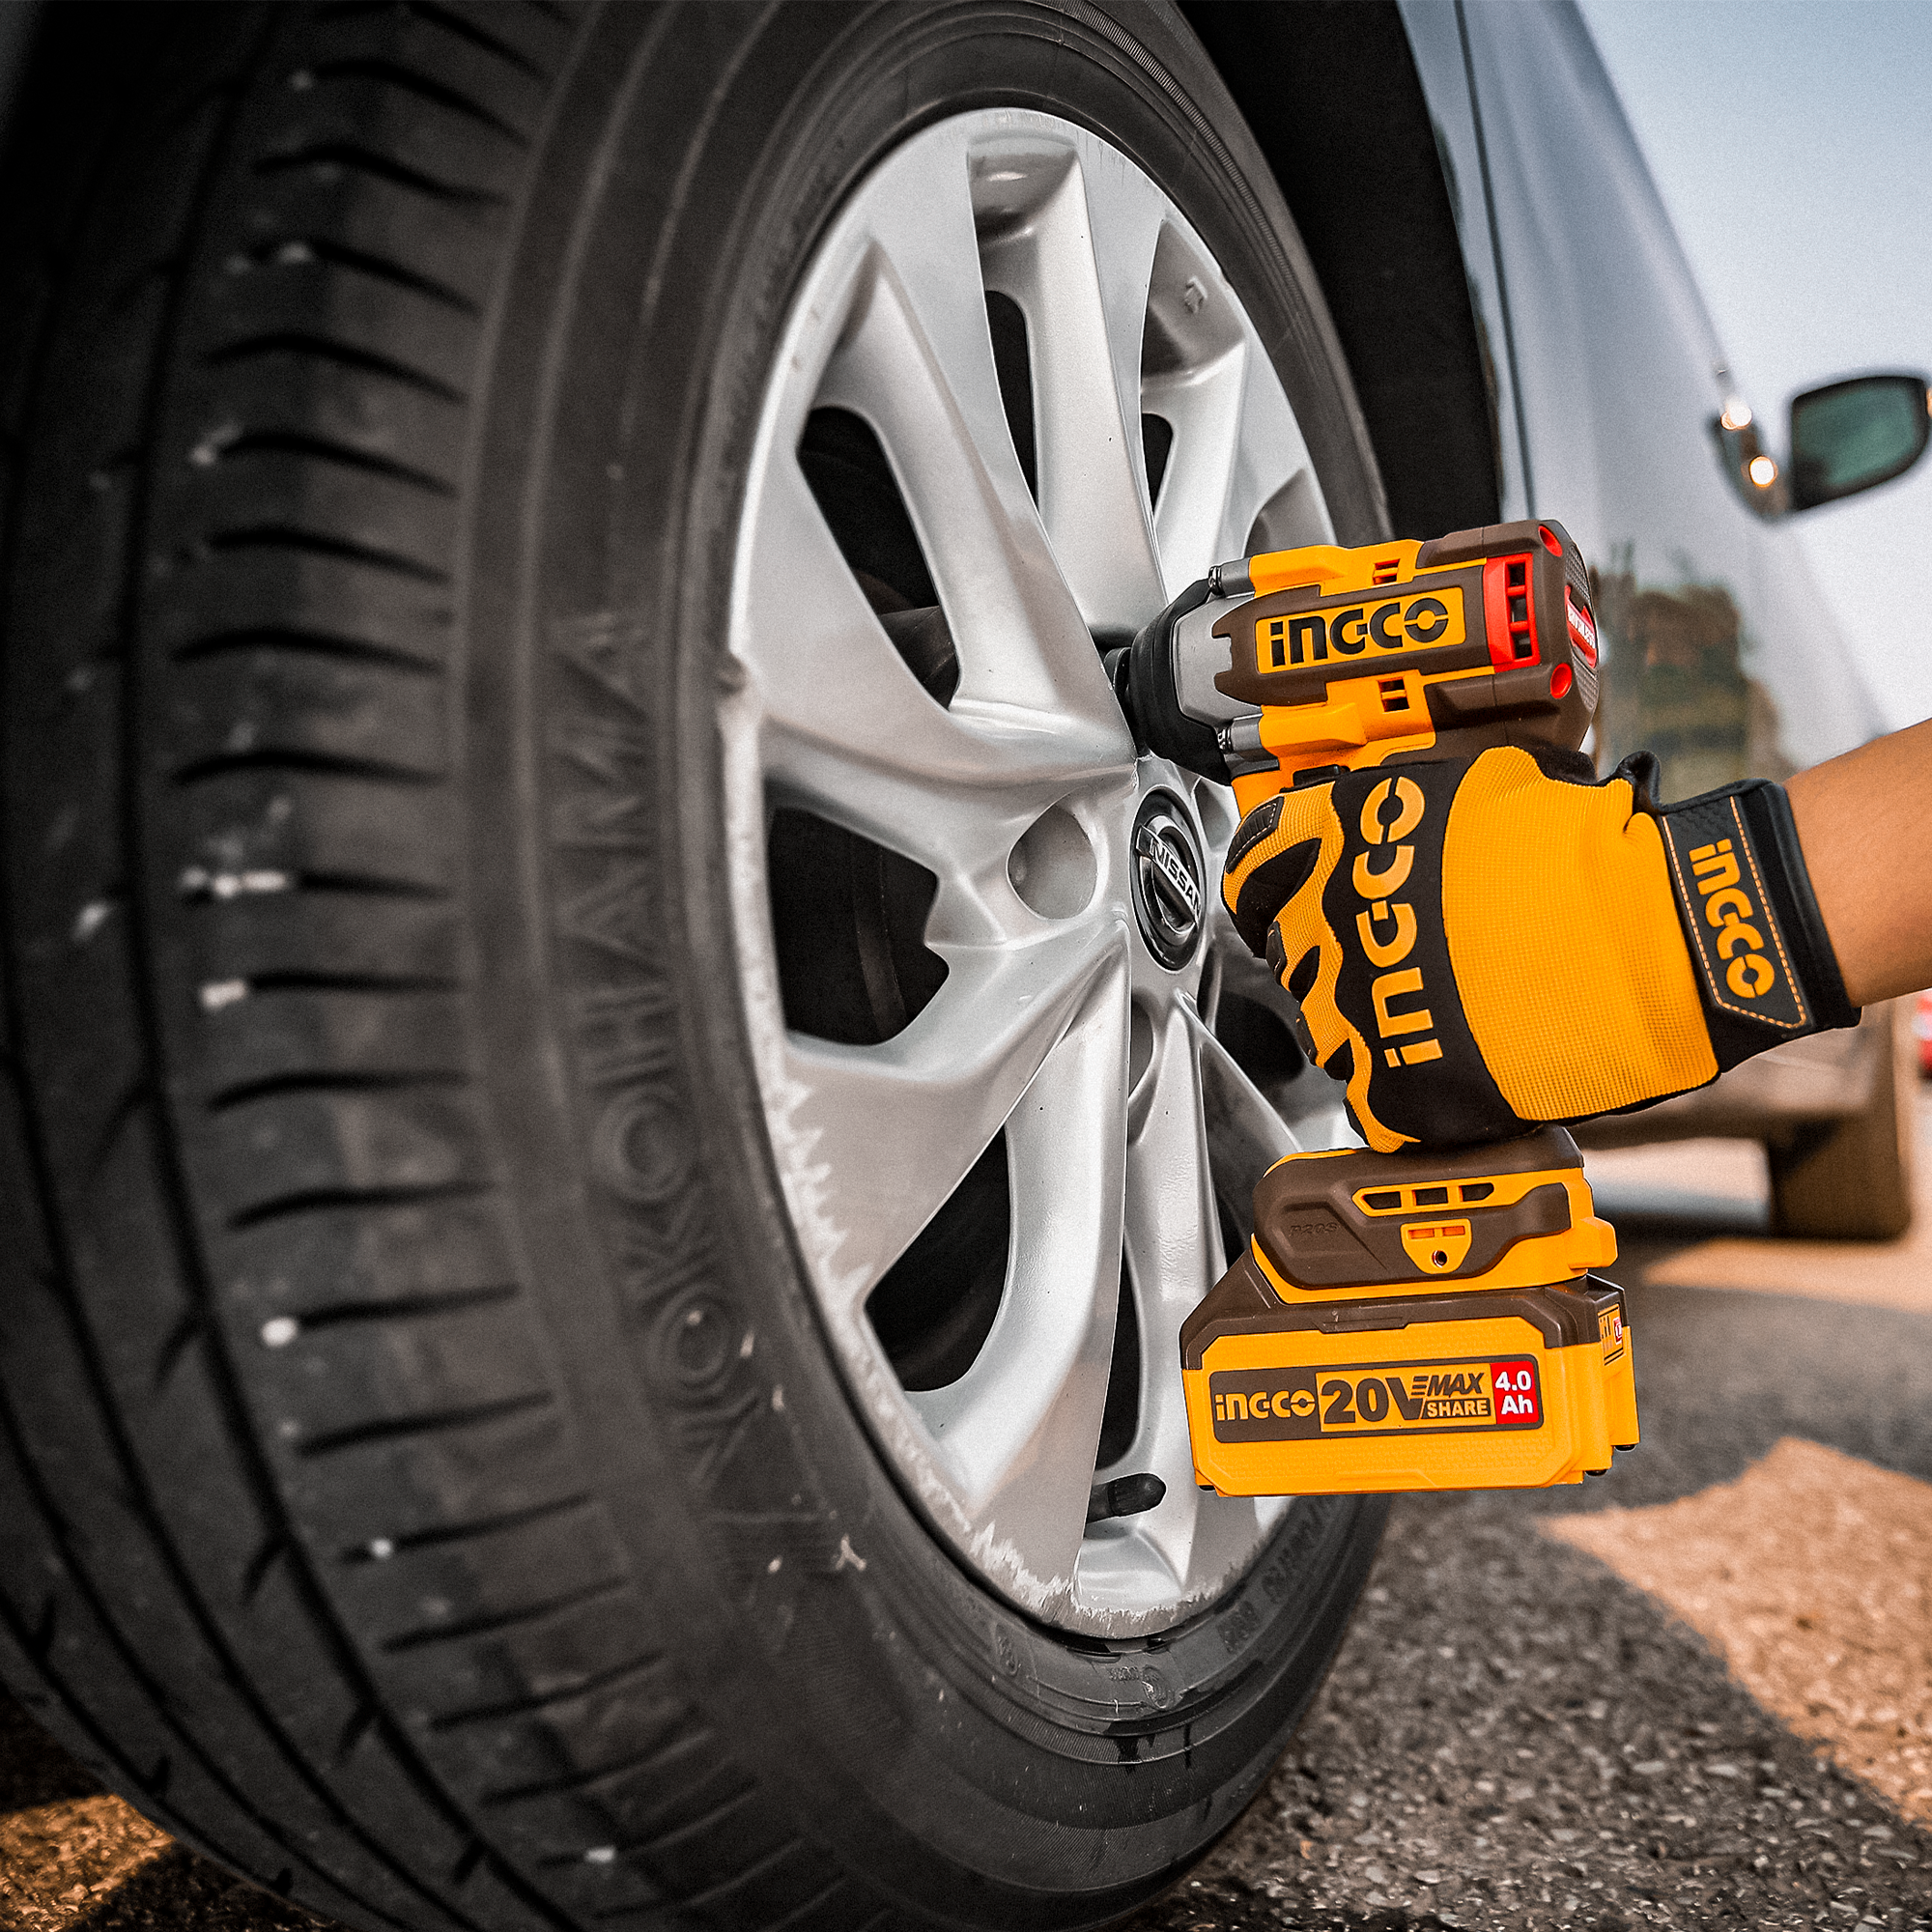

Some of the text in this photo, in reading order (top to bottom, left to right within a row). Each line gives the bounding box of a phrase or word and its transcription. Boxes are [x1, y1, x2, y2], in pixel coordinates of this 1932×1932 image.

[1151, 839, 1200, 918] NISSAN
[1426, 1372, 1485, 1398] MAX
[1494, 1370, 1532, 1392] 4.0
[1321, 1376, 1425, 1425] 20V
[1426, 1400, 1489, 1418] SHARE
[1500, 1394, 1534, 1415] Ah
